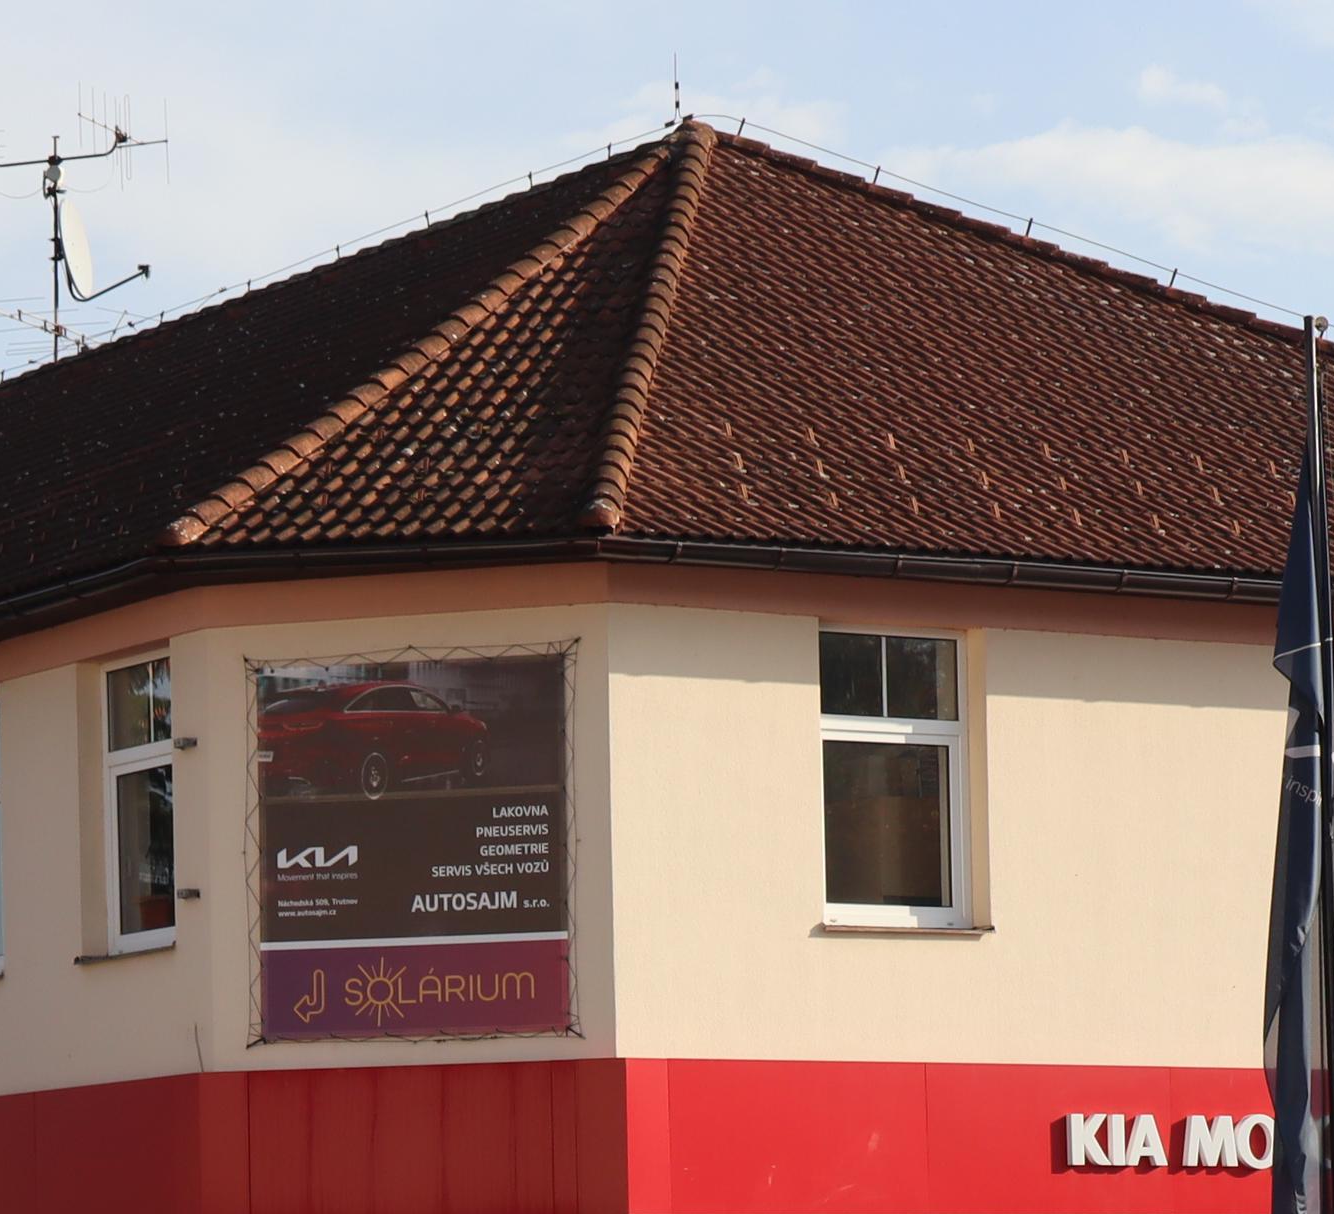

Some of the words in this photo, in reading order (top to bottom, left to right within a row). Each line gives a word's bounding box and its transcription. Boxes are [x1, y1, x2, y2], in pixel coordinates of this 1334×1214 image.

[492, 805, 548, 818] LAKOVNA
[476, 823, 549, 838] PNEUSERVIS
[277, 845, 359, 869] KIA
[480, 842, 549, 857] GEOMETRIE
[277, 873, 315, 881] Movement
[332, 872, 358, 881] inspires
[431, 864, 473, 878] SERVIS
[475, 860, 514, 876] VŠECH
[516, 859, 549, 875] VOZŮ
[411, 891, 518, 913] AUTOSAJM
[523, 898, 550, 909] s.r.o.
[344, 967, 536, 1006] SOLÁRIUM
[1066, 1113, 1168, 1168] KIA
